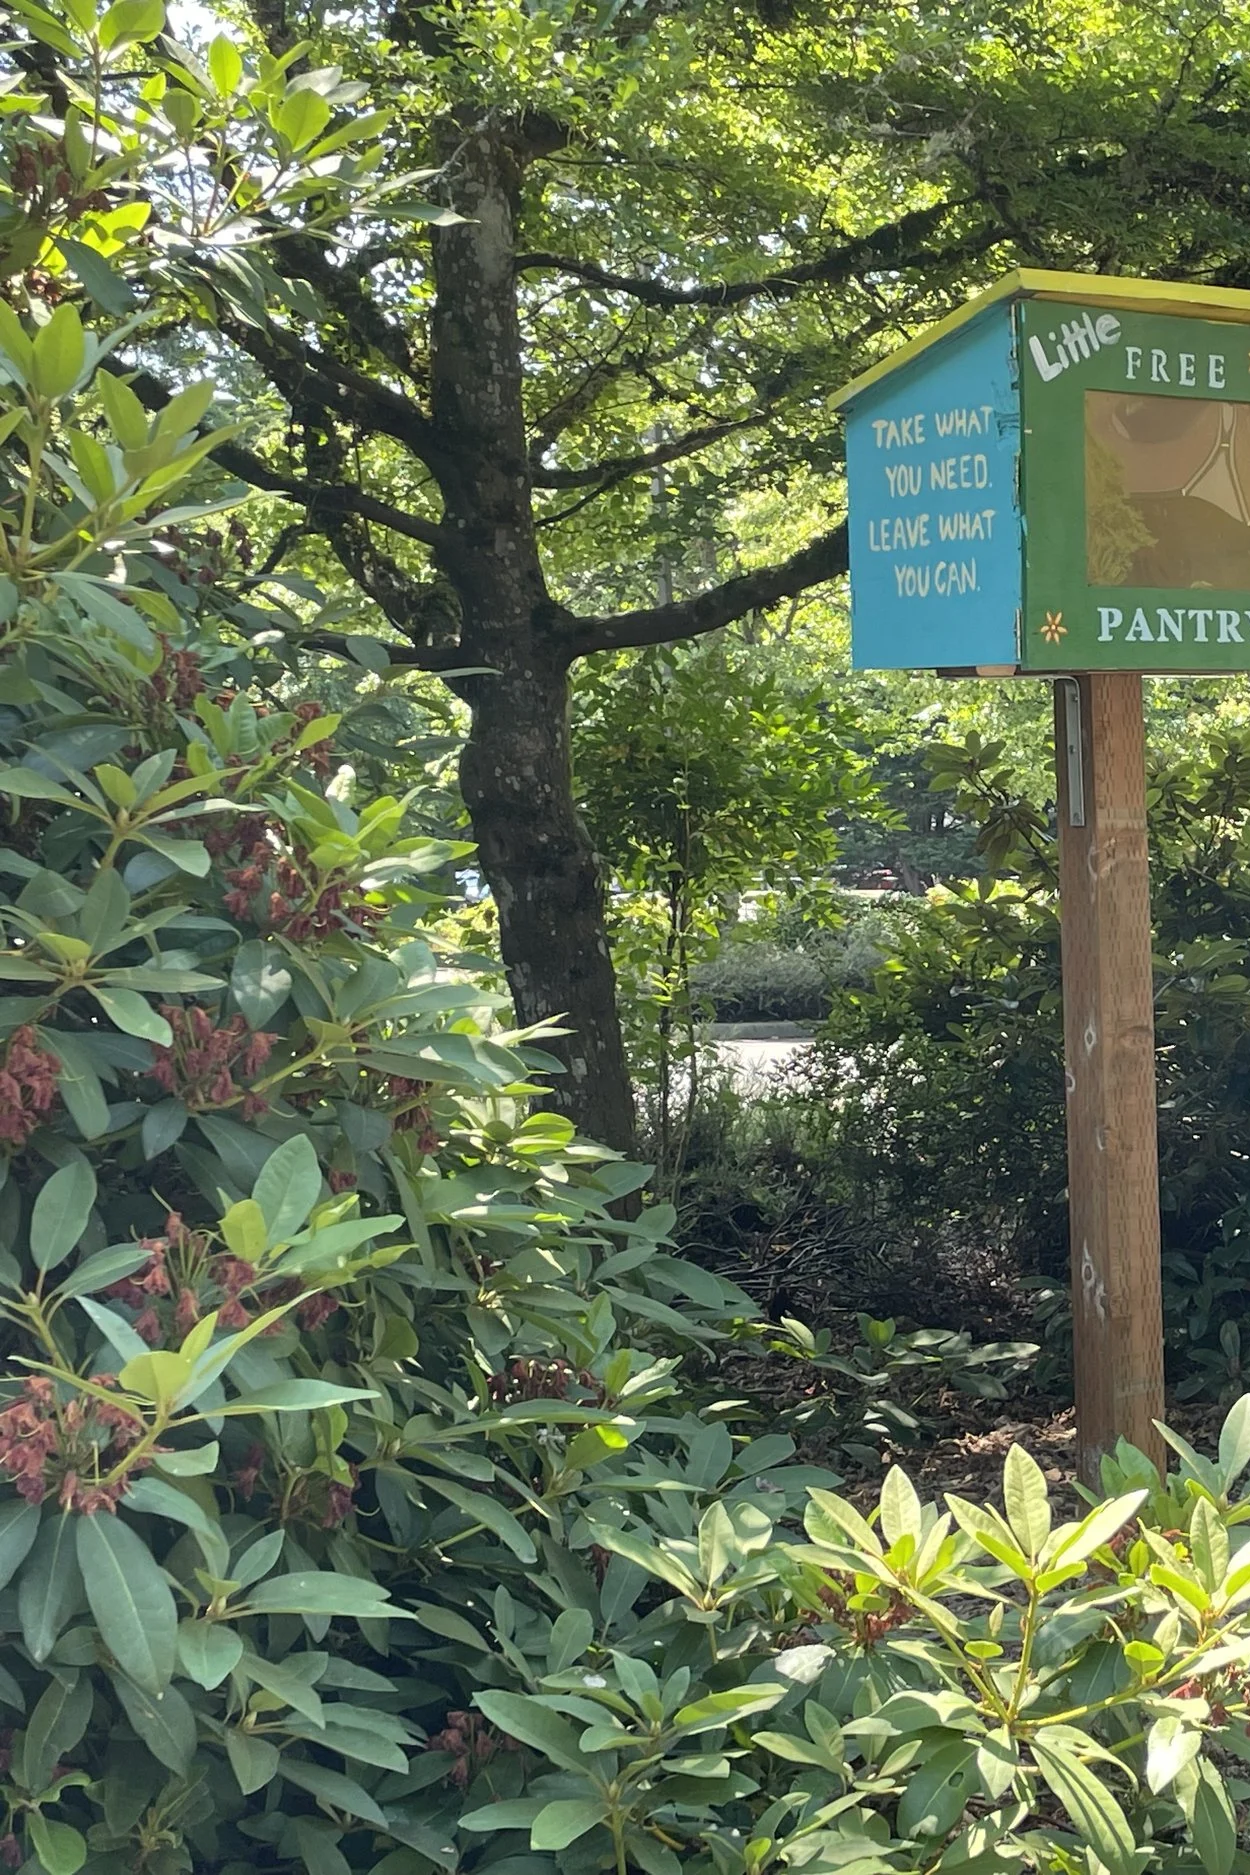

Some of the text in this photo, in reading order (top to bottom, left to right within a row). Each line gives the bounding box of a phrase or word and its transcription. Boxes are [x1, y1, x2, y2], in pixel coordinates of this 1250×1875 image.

[1029, 311, 1121, 382] Little
[1125, 346, 1227, 388] FREE
[872, 406, 994, 449] TAKE WHAT
[885, 453, 992, 498] YOU NEED.
[869, 509, 997, 552] LEAVE WHAT
[894, 558, 981, 597] YOU CAN.
